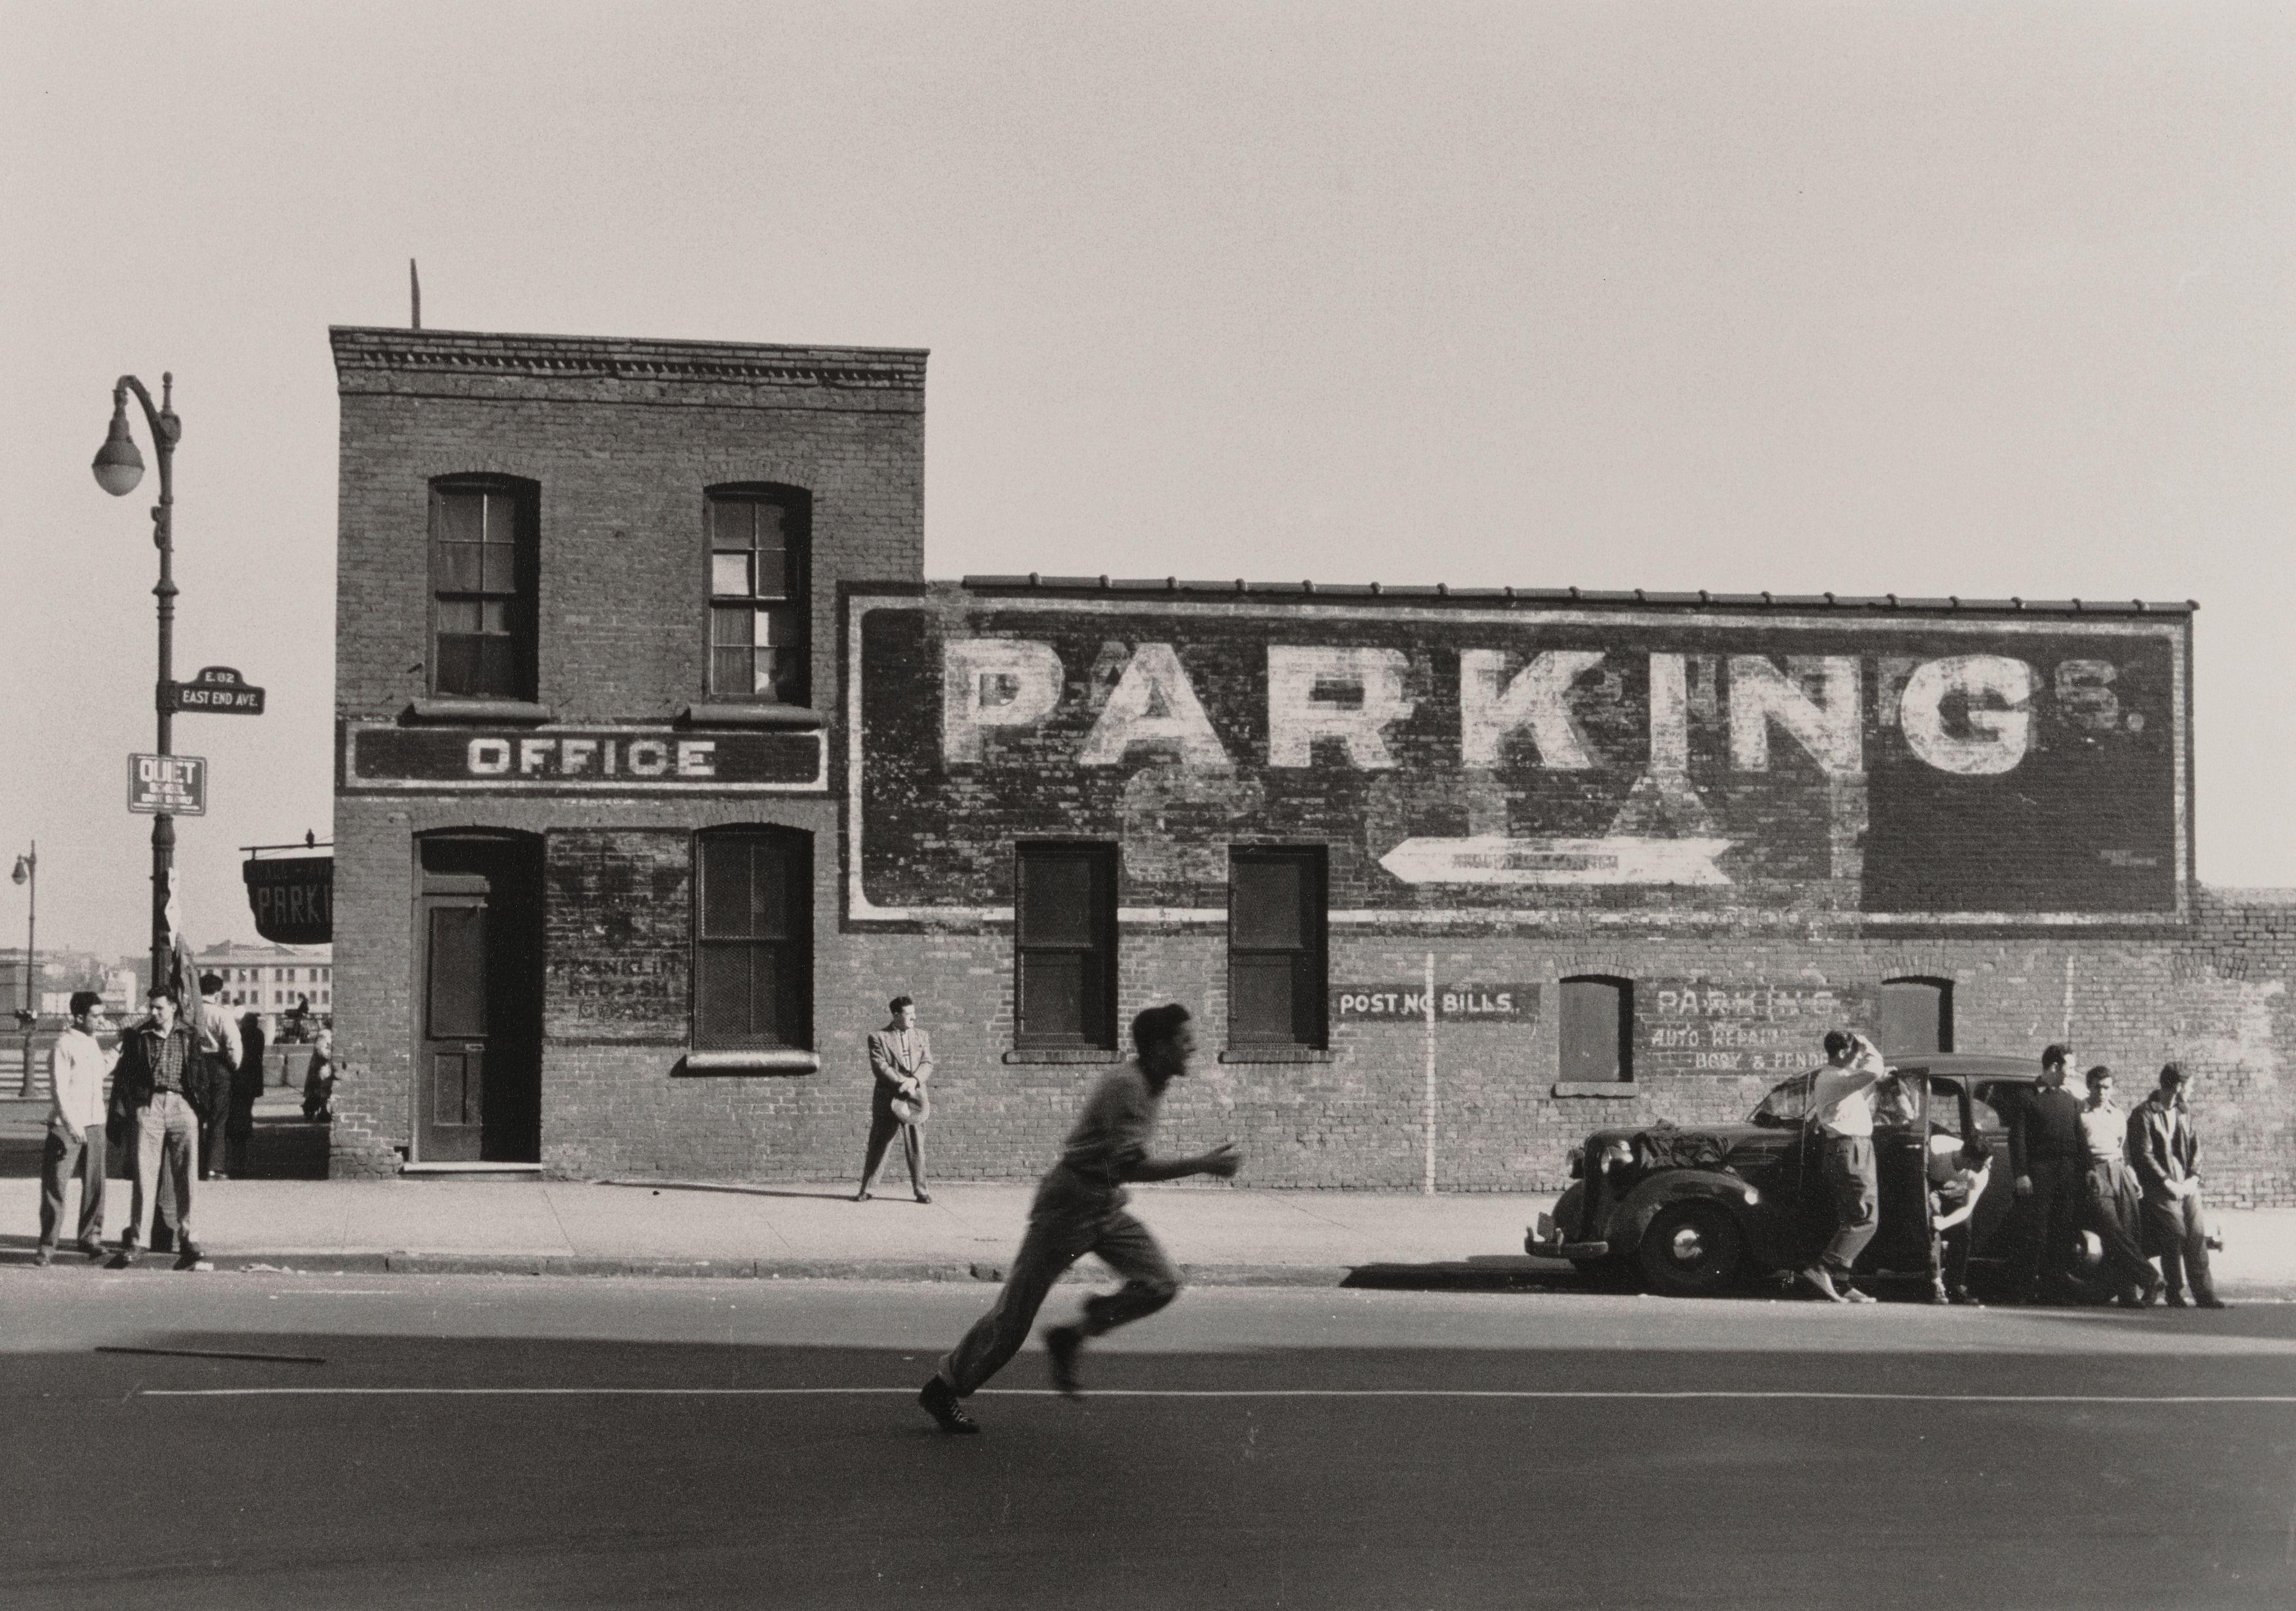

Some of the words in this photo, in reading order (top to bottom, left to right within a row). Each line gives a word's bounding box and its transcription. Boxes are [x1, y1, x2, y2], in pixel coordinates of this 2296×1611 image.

[182, 690, 210, 704] EAST
[212, 692, 233, 705] END
[235, 694, 258, 706] AVE.
[468, 738, 716, 775] OFFICE
[140, 759, 196, 784] QUIET
[1340, 993, 1398, 1014] POST
[1652, 1028, 1699, 1047] AUTO
[1696, 1053, 1741, 1069] BODY
[1753, 1055, 1765, 1070] &
